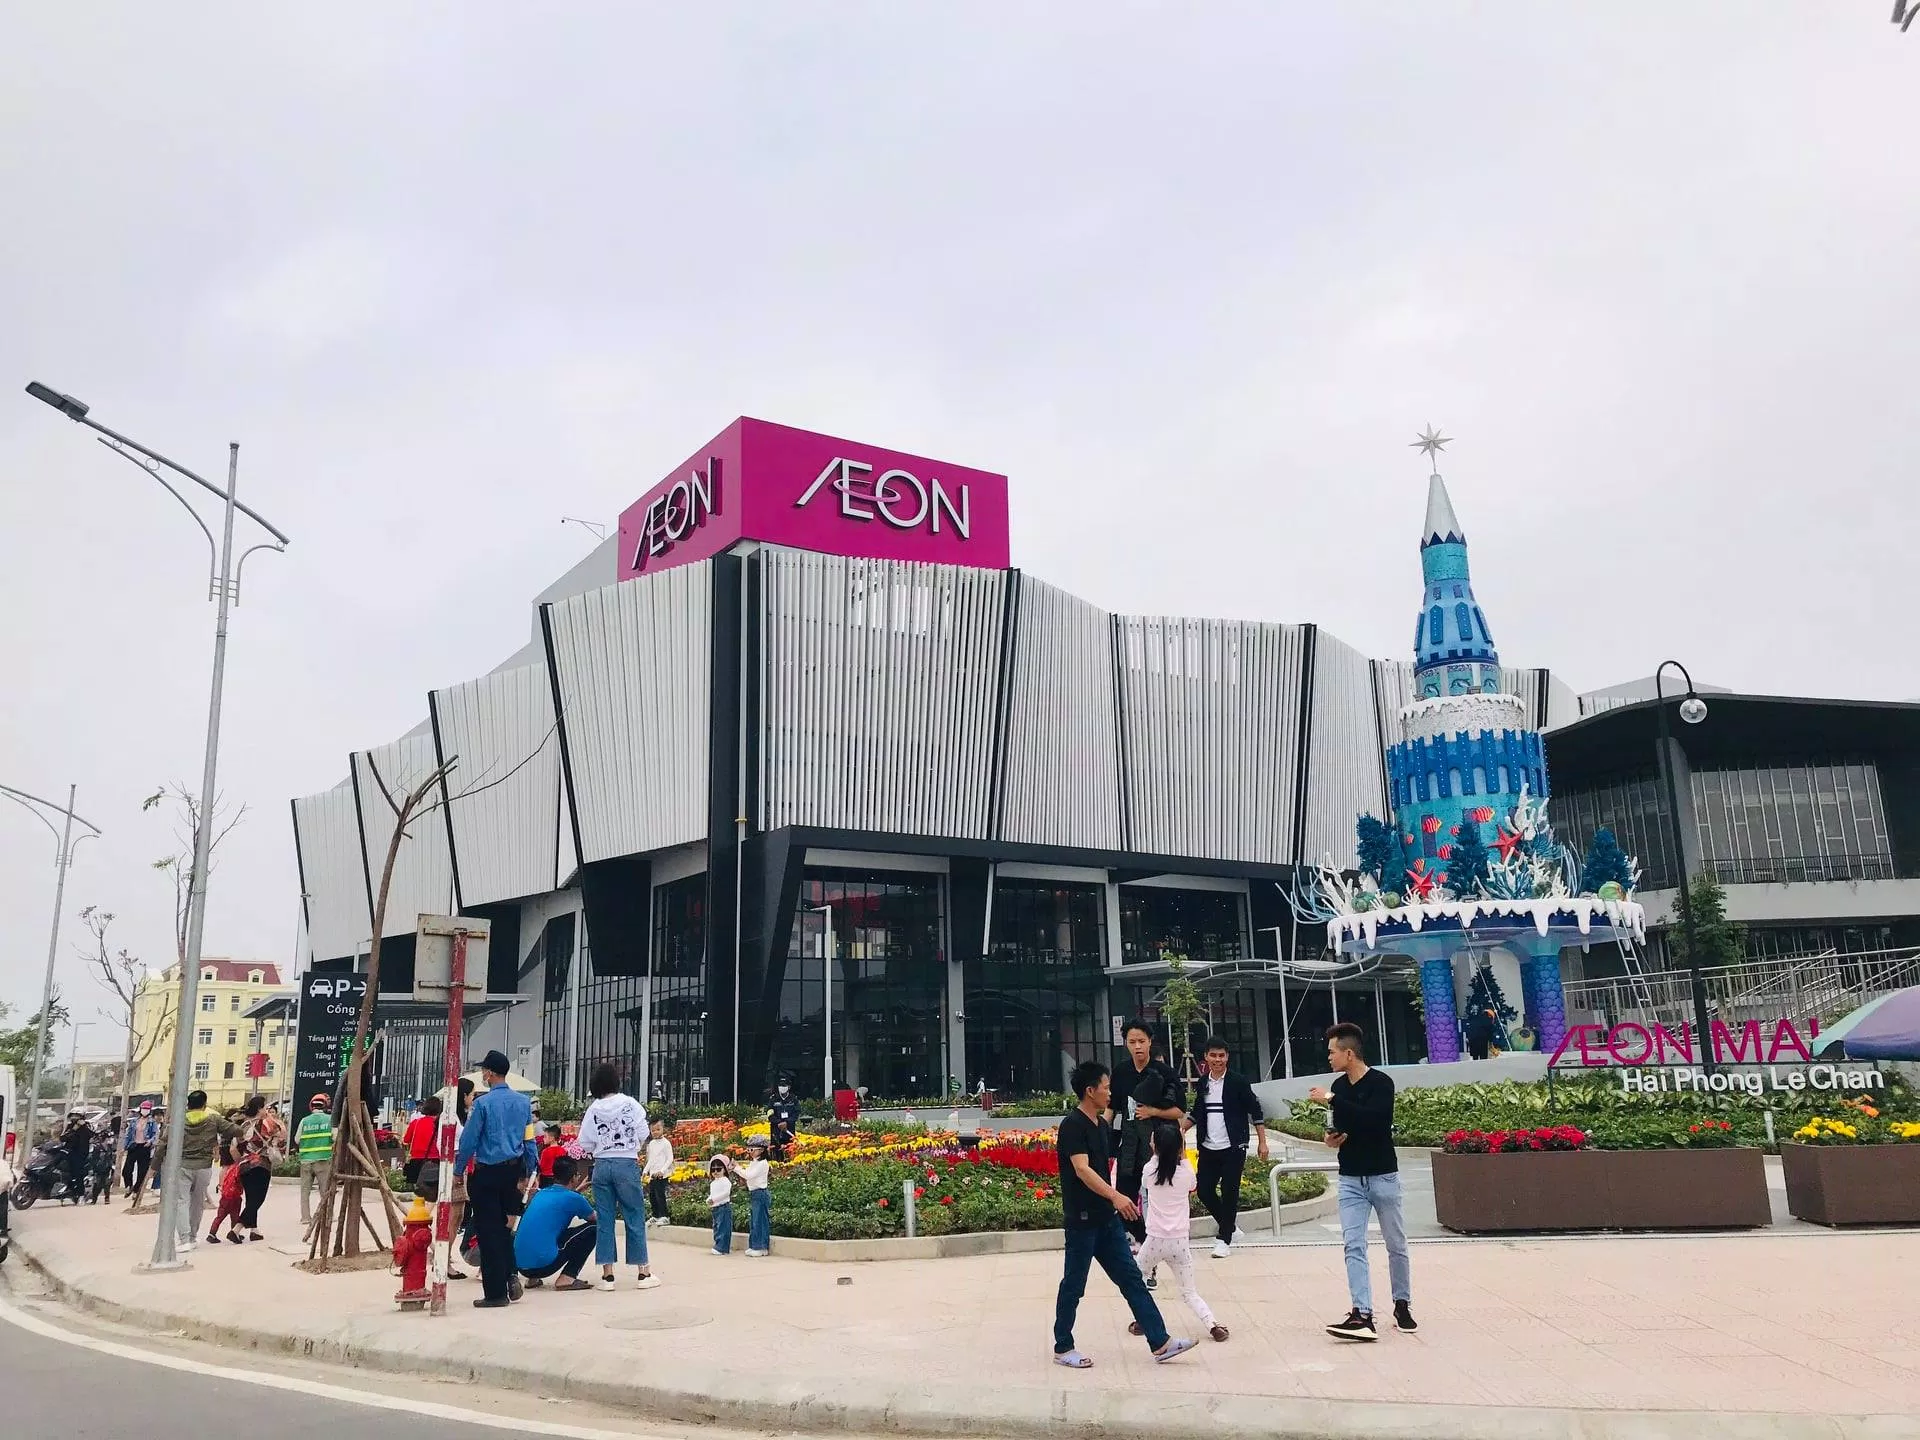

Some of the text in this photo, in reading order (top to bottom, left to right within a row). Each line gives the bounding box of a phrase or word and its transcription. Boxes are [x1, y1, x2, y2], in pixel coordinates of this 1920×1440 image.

[335, 979, 350, 998] P
[326, 1002, 355, 1016] Cổng
[1621, 1065, 1885, 1096] Hai Phong Le Chan
